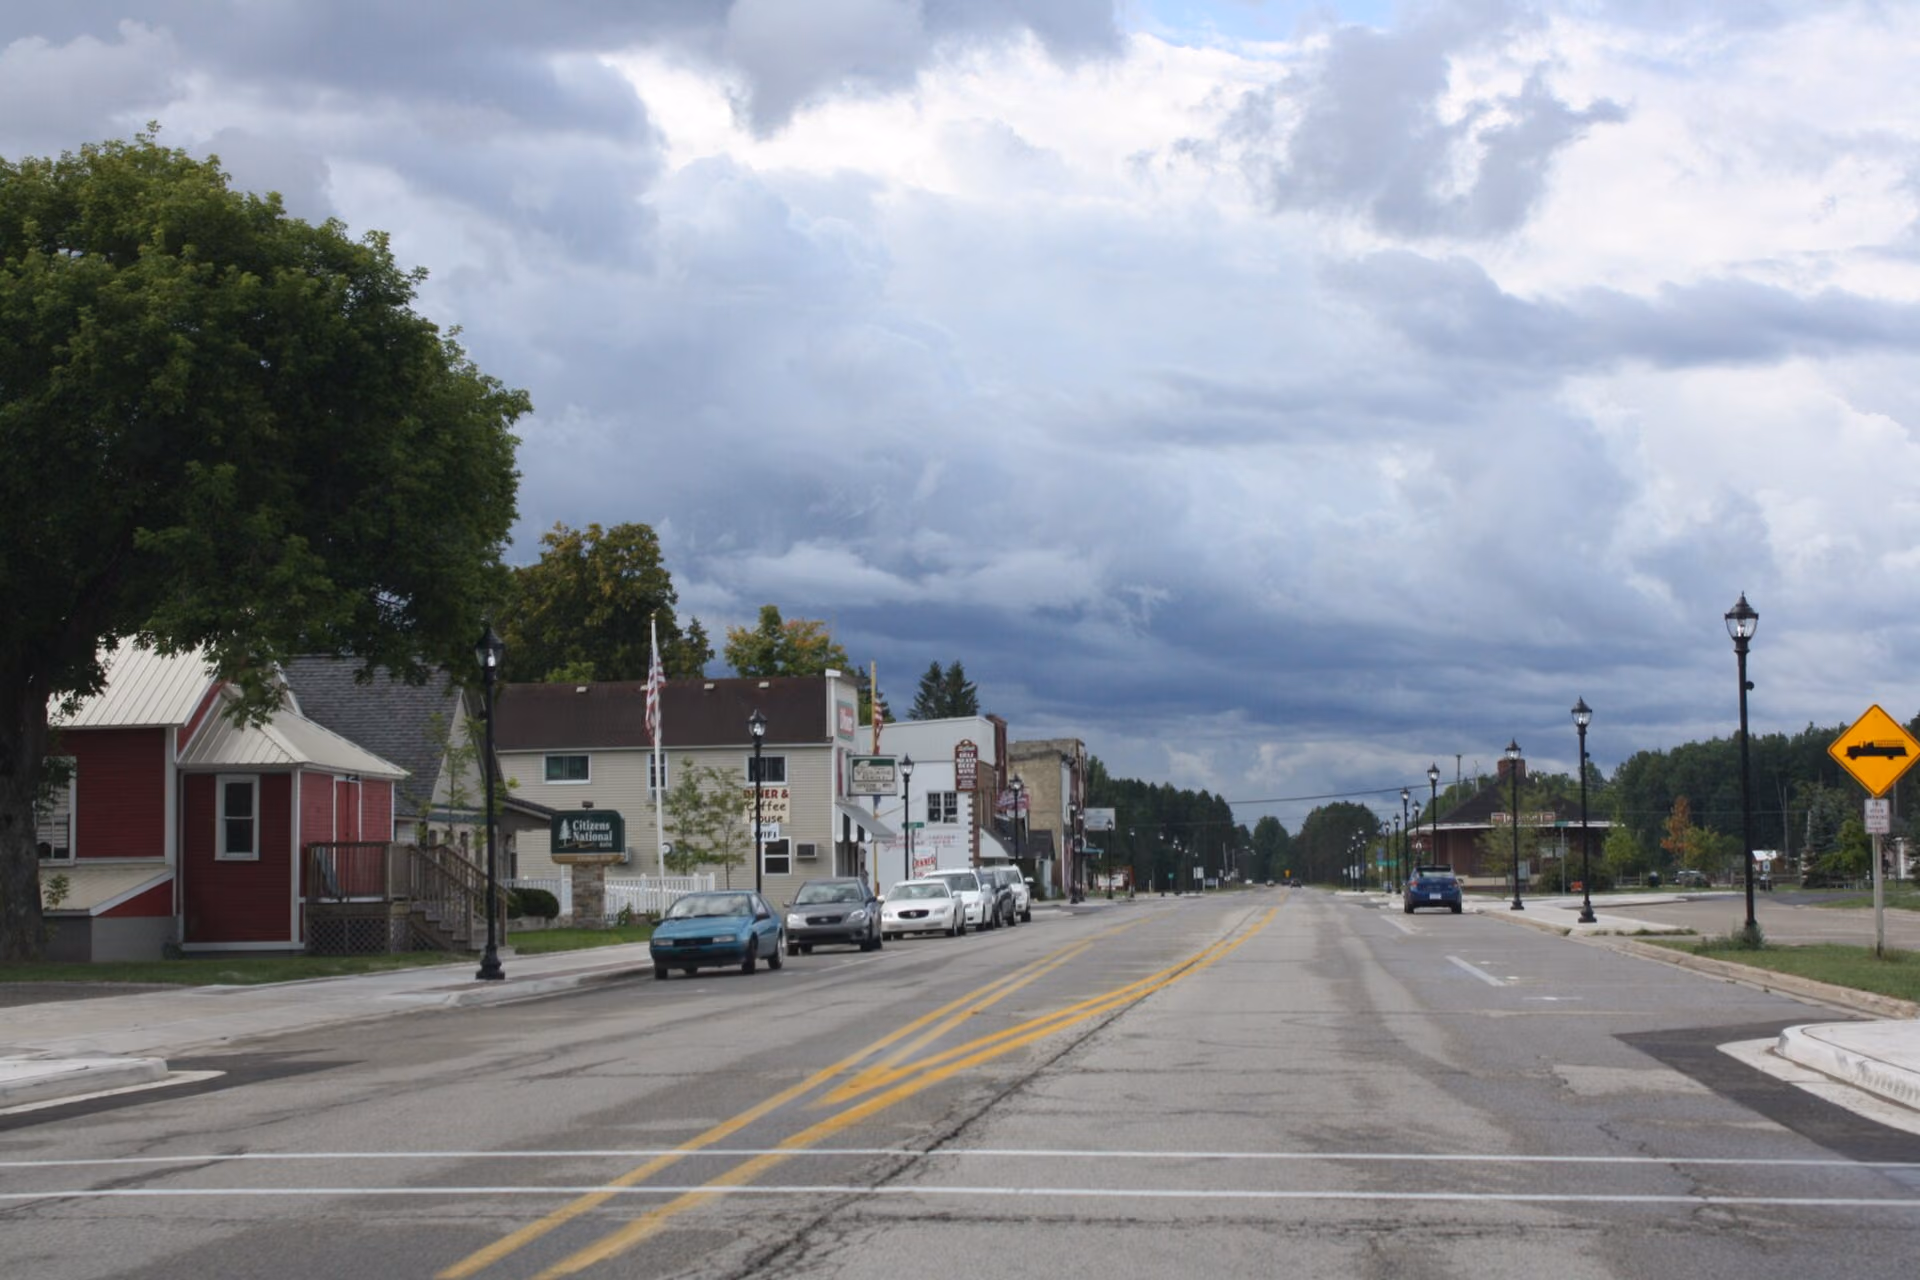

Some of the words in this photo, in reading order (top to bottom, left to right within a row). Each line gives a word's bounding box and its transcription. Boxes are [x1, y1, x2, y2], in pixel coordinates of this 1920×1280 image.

[781, 789, 789, 798] &
[746, 800, 786, 811] Cffee
[572, 820, 611, 830] Citizens
[572, 830, 613, 841] National
